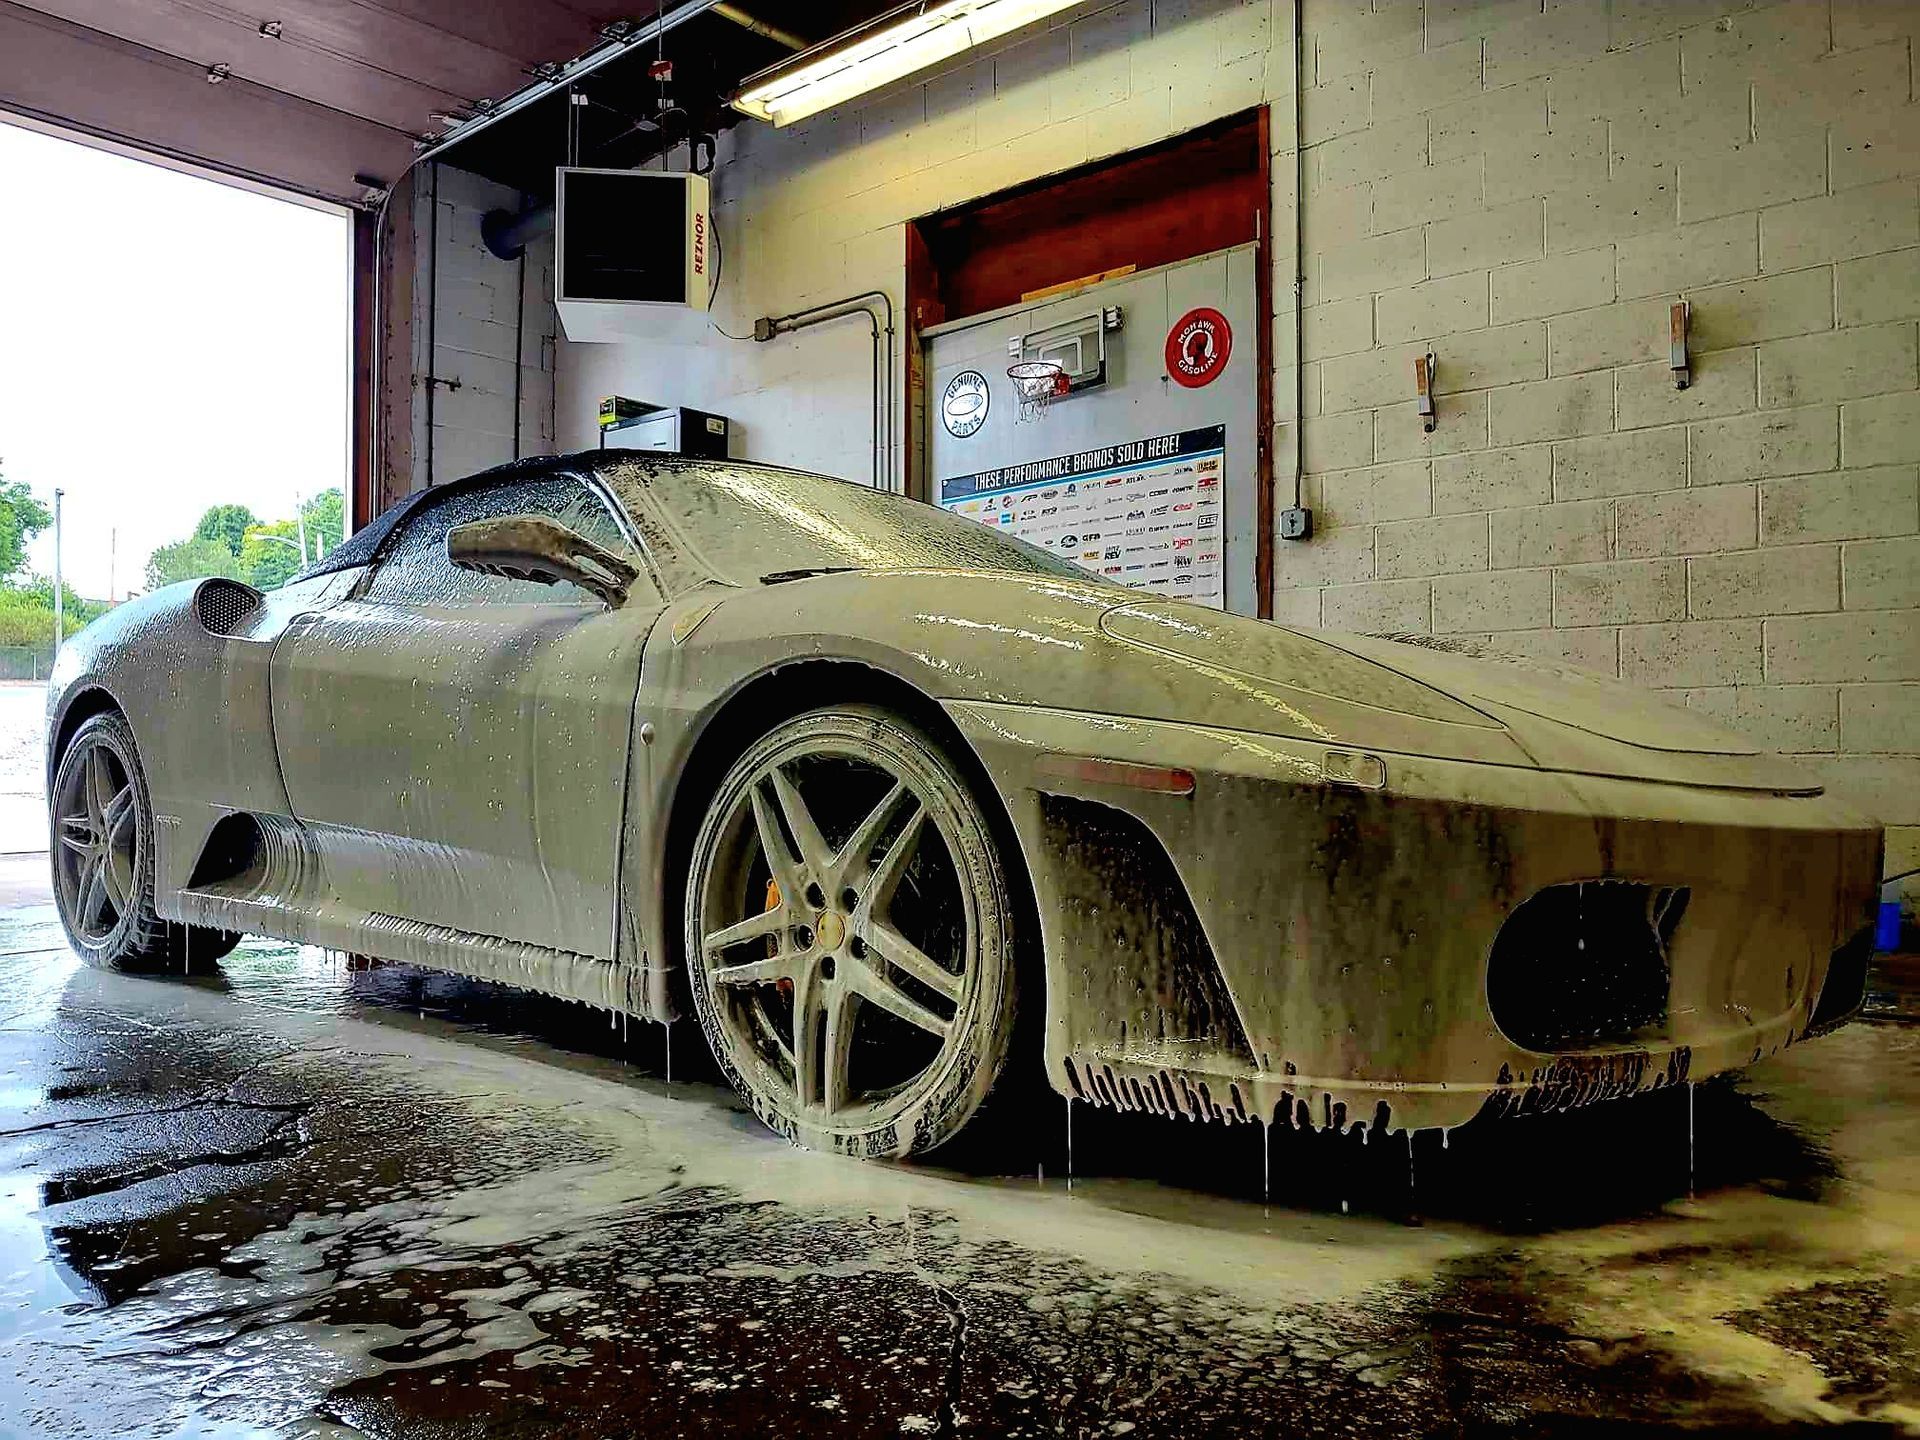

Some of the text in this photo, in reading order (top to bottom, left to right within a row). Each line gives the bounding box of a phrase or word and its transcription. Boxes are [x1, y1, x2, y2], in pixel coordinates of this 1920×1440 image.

[695, 213, 703, 275] REZNOR
[1178, 320, 1215, 344] MOHAWK
[1178, 352, 1218, 375] GASOLINE
[947, 374, 984, 398] GENUINE
[951, 414, 981, 435] PARTS
[975, 435, 1180, 491] THESE PERFORMANCE BRANDS SOLD HERE!
